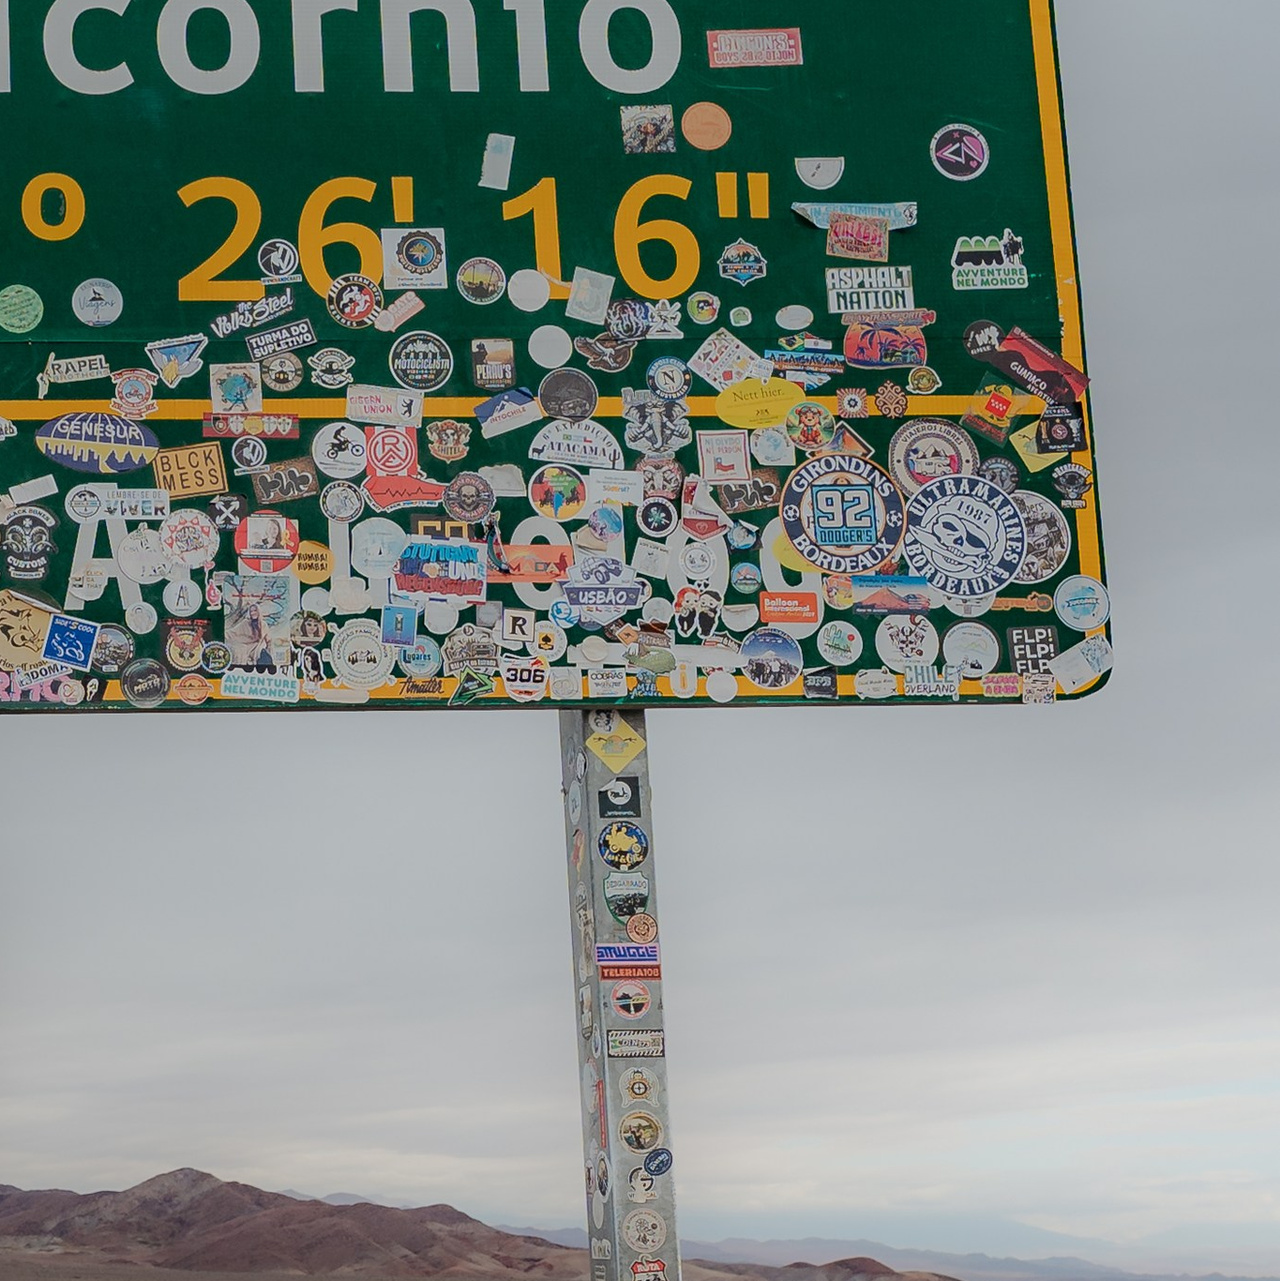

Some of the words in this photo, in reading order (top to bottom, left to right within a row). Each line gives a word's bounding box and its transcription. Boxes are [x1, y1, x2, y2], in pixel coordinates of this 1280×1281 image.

[829, 268, 909, 289] ASPHALT
[956, 268, 1025, 277] AVVENTURE
[956, 278, 978, 287] NEL
[981, 278, 1026, 286] MONDO
[253, 287, 295, 318] Steel
[837, 290, 906, 310] NATION
[249, 330, 290, 348] TURMA
[292, 323, 308, 335] DO
[254, 333, 312, 358] SUPLETIVO
[1010, 361, 1048, 390] GUANACO
[655, 385, 689, 399] AUSTRALIA
[733, 391, 758, 402] Nett
[760, 387, 785, 399] hier.
[363, 405, 392, 414] UNION
[58, 421, 141, 440] GENESUR
[902, 424, 938, 444] VIAJEROS
[939, 425, 965, 446] LIBRES
[546, 441, 608, 457] ATACAMA
[160, 448, 214, 472] BLCK
[162, 471, 219, 492] MESS
[791, 456, 895, 497] GIRONDINS
[817, 490, 872, 528] 92
[956, 501, 992, 524] 1987
[909, 477, 1023, 564] ULTRAMARINES
[820, 530, 873, 543] DODGER'S
[7, 556, 47, 569] CUSTOM
[793, 535, 895, 573] BORDEAUX
[907, 545, 1000, 595] BORDEAUX
[579, 587, 627, 604] USBÃO
[764, 598, 798, 607] Balloon
[510, 616, 528, 635] R
[1012, 628, 1053, 644] FLP!
[402, 647, 431, 662] Lugares
[1014, 643, 1056, 658] FLP!
[225, 674, 296, 689] AVVENTURE
[506, 667, 546, 682] 306
[590, 672, 624, 680] COBRAS
[905, 665, 954, 683] CHILE
[224, 685, 245, 696] NEL
[248, 686, 295, 699] MONDO
[905, 683, 956, 695] OVERLAND
